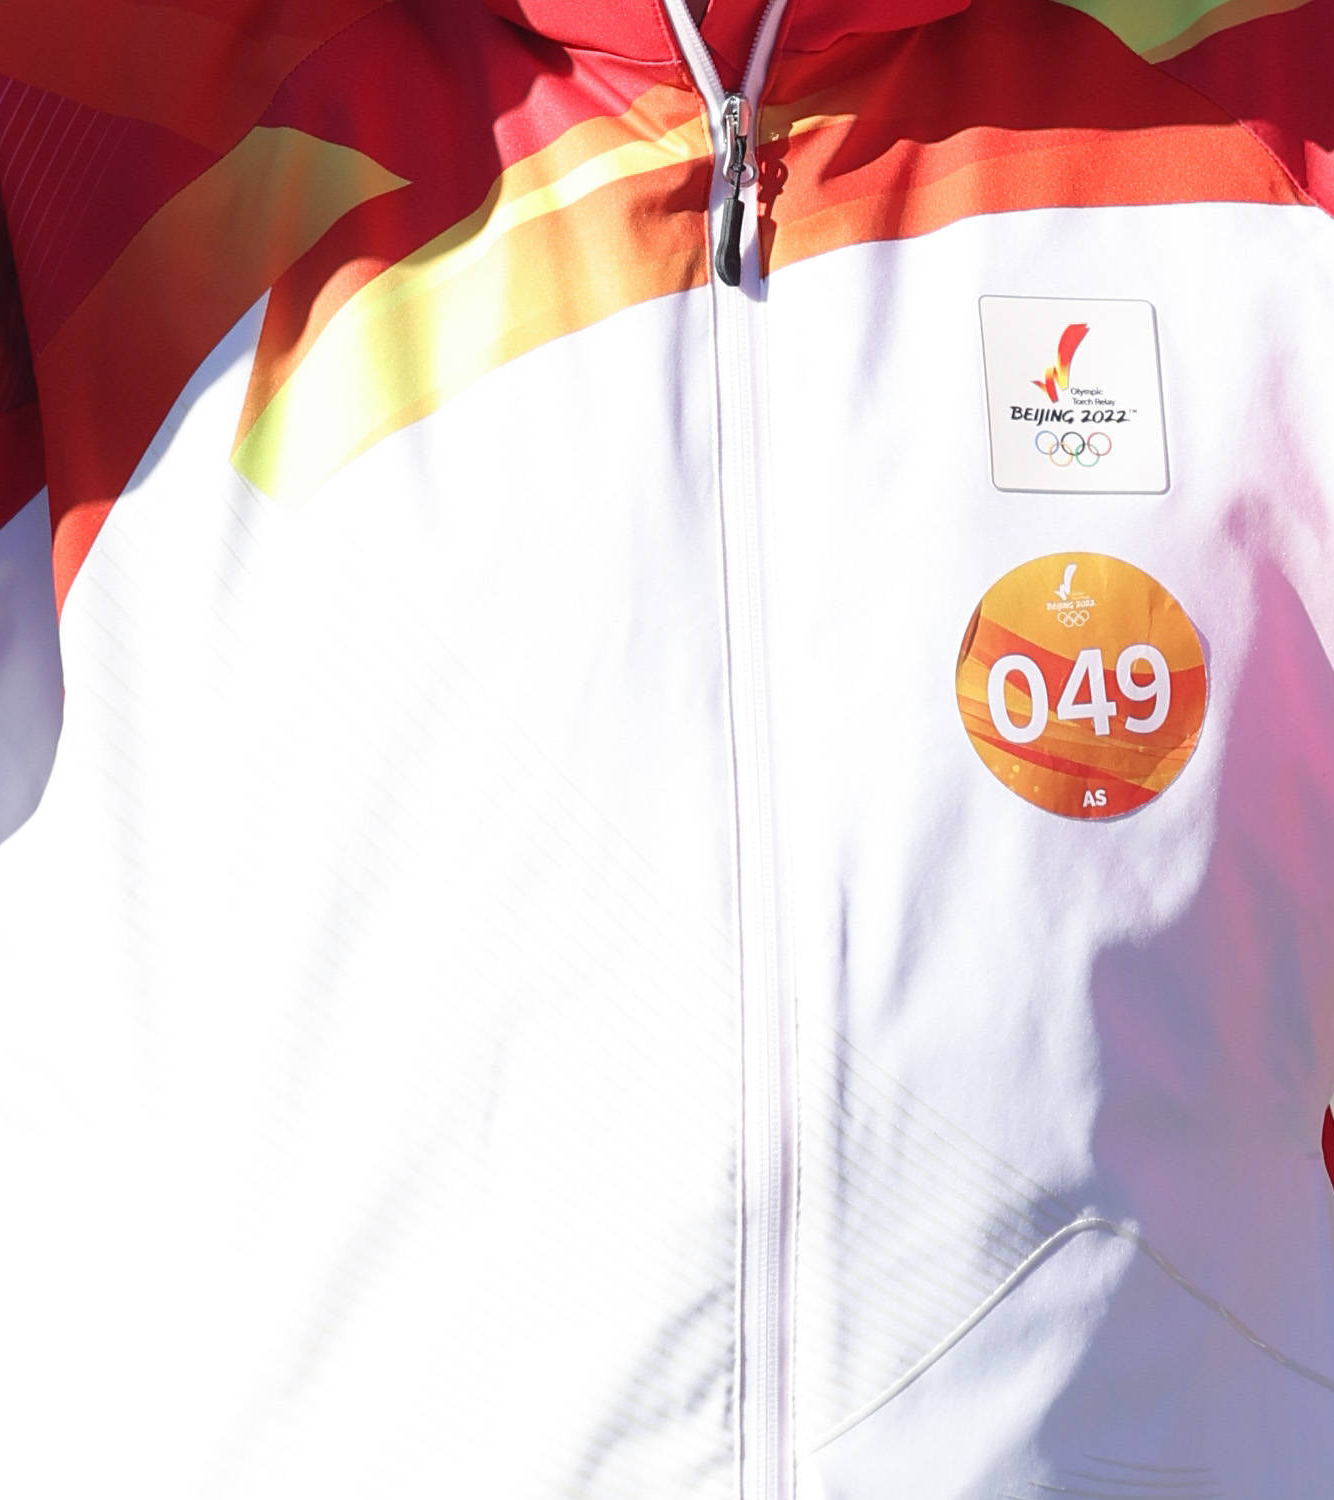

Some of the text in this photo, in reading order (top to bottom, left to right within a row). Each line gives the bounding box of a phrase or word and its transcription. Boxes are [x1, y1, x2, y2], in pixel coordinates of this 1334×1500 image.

[1070, 387, 1103, 396] Olympic
[1073, 398, 1115, 406] Torch Relay
[1010, 406, 1074, 426] BEIJING
[987, 643, 1171, 744] 049
[1082, 789, 1107, 807] AS
